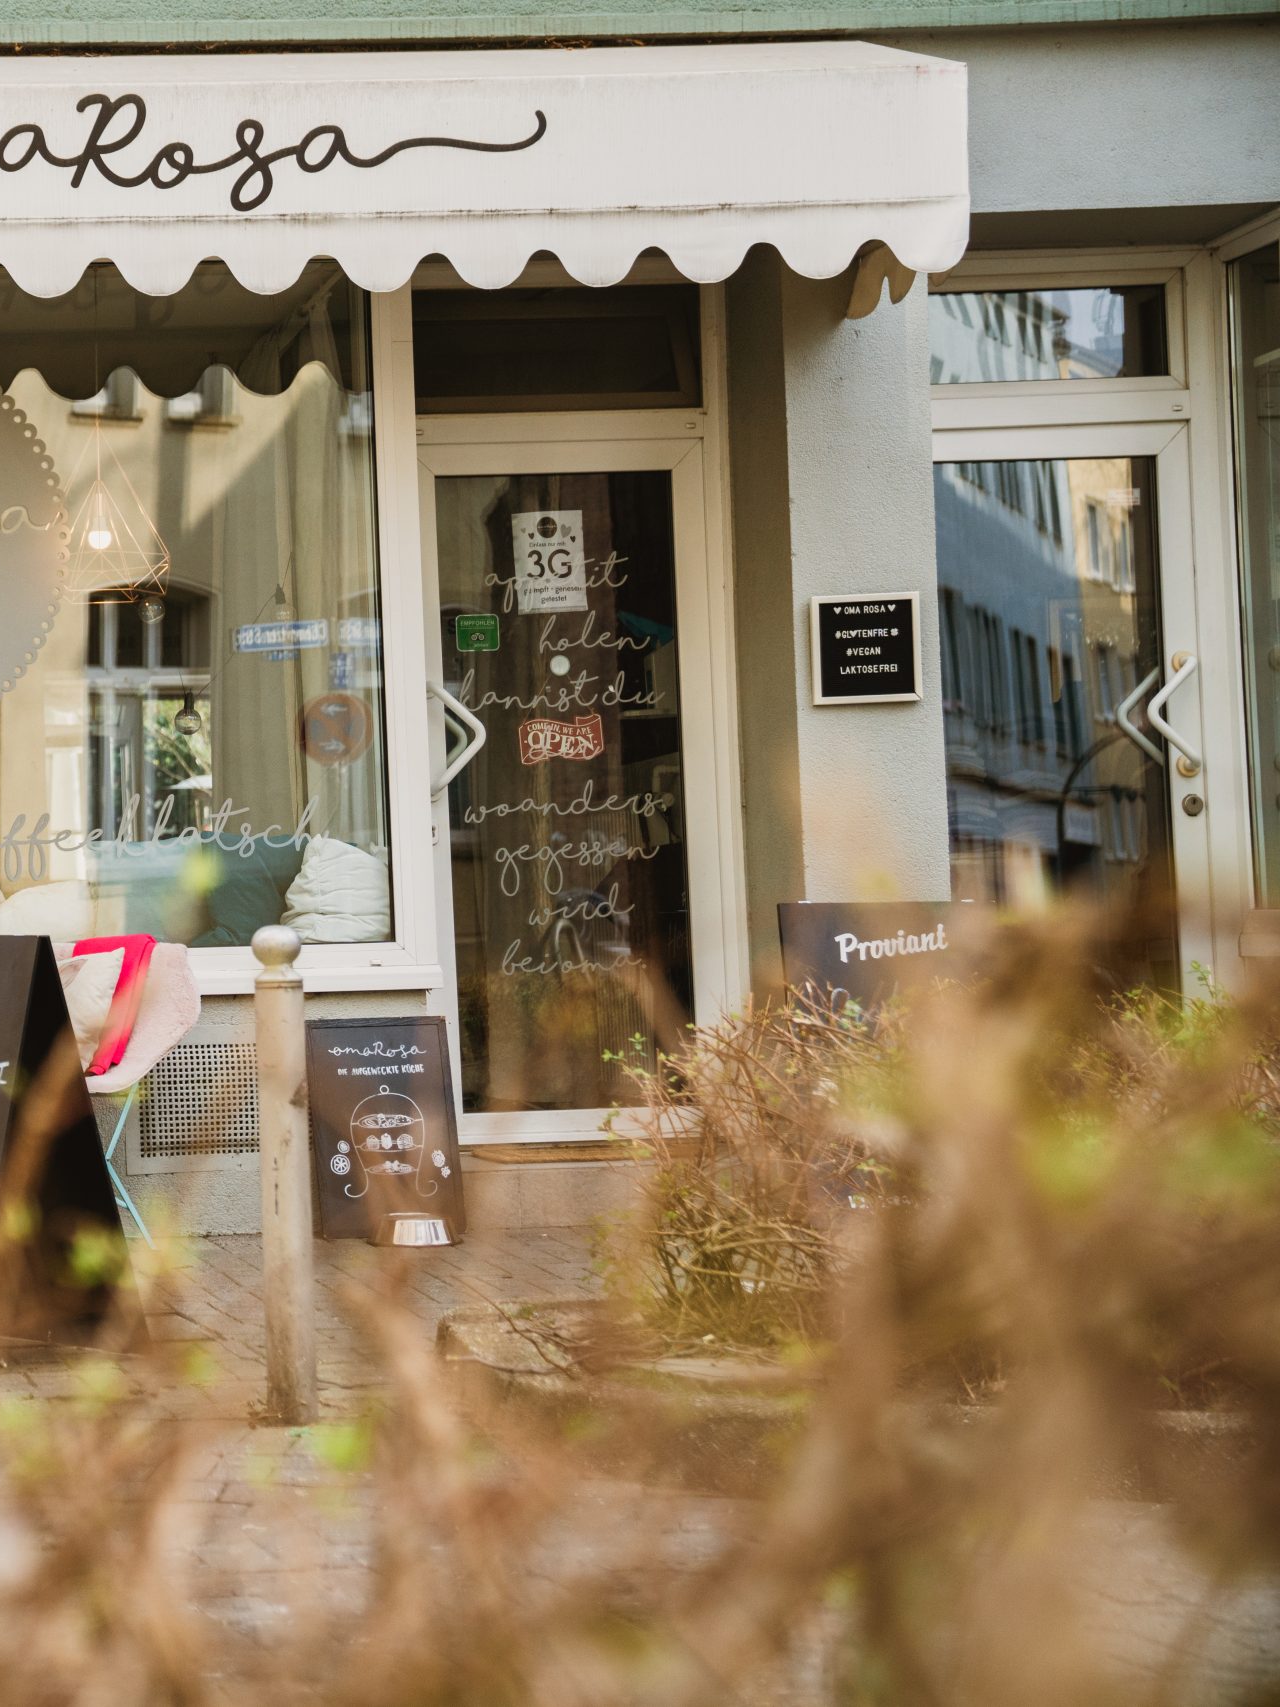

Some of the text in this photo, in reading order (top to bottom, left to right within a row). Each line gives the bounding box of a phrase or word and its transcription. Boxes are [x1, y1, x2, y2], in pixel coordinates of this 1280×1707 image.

[527, 549, 573, 579] 3G
[844, 604, 886, 614] OMA ROSA
[540, 611, 650, 654] holen
[840, 663, 898, 675] LAKTOSEFREI
[459, 669, 665, 711] kannst du
[527, 722, 549, 732] COME
[562, 726, 574, 735] WE
[576, 726, 592, 735] ARE
[527, 731, 595, 754] OPEN
[495, 840, 660, 896] gegessen
[528, 882, 635, 926] wird
[834, 923, 949, 963] Proviant
[328, 1041, 427, 1059] omaRosa
[337, 1067, 348, 1076] DIE
